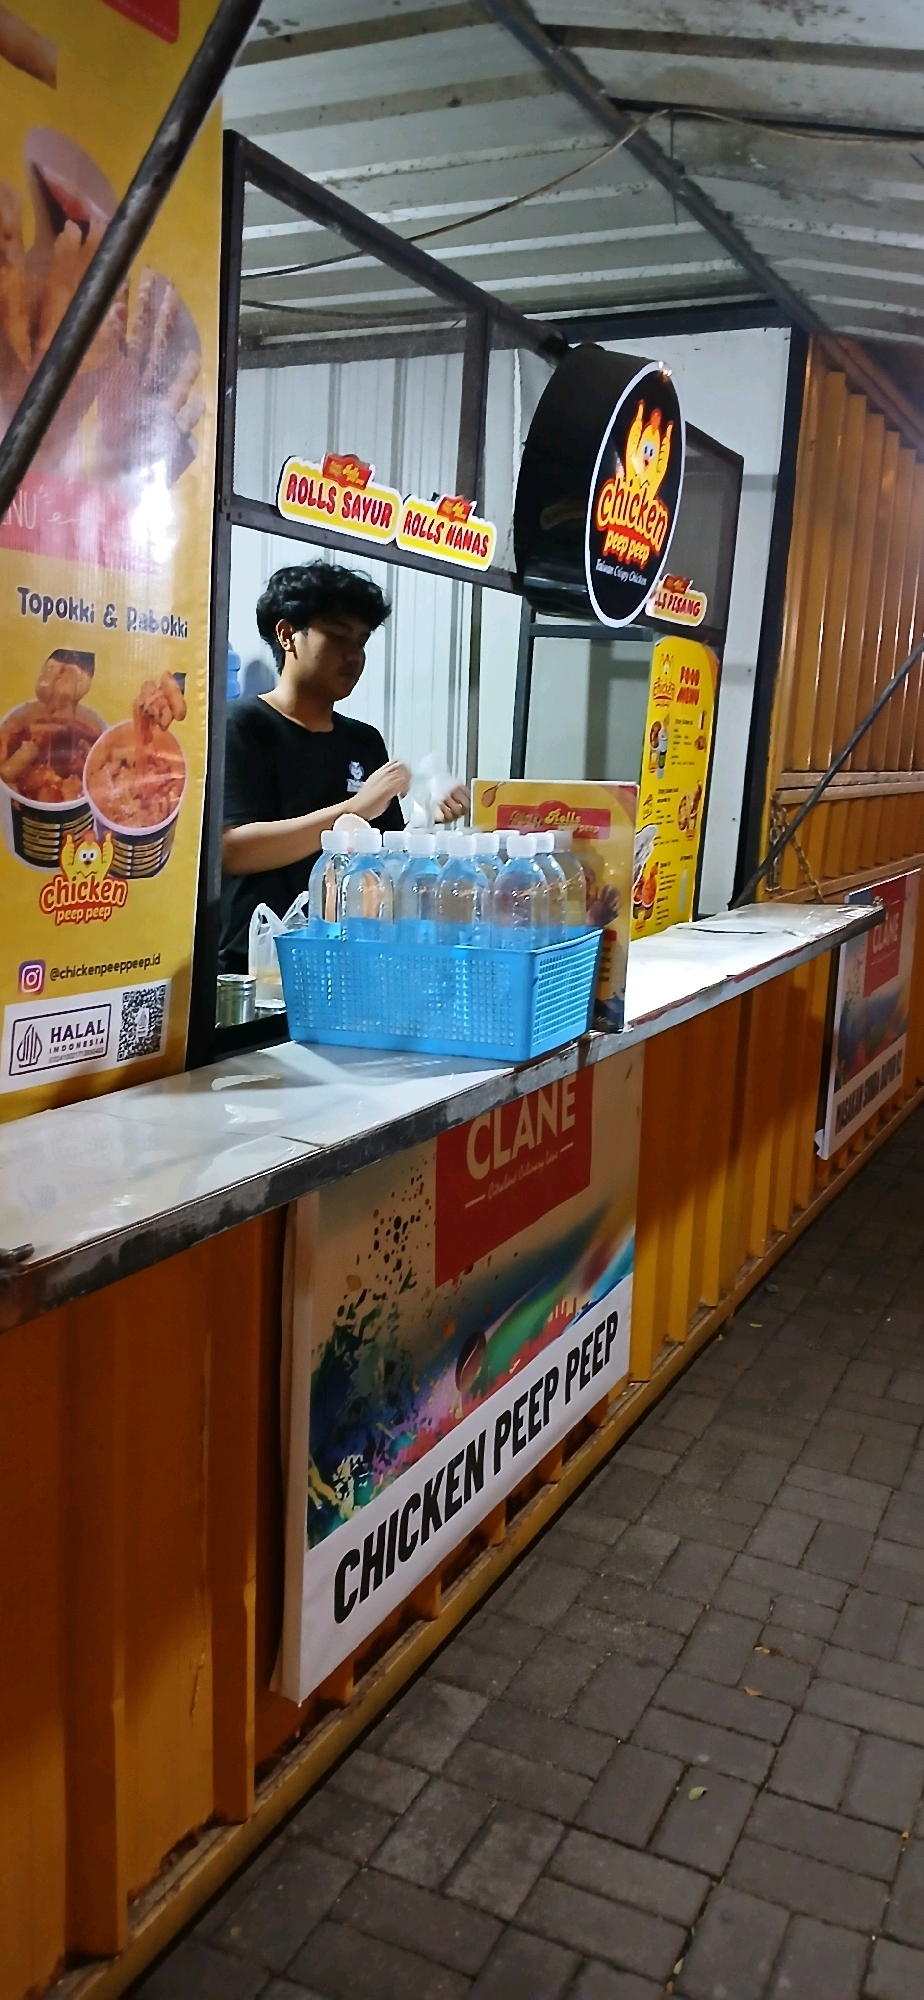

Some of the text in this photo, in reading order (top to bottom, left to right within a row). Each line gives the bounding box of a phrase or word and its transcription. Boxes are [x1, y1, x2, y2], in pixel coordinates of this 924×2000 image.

[286, 473, 337, 515] ROLLS
[341, 490, 393, 529] SAYUR
[598, 475, 668, 552] chicken
[403, 510, 445, 544] ROLLS
[445, 524, 490, 558] NANAS
[604, 530, 650, 565] peep peep
[17, 586, 95, 623] Topokki
[103, 604, 118, 629] &
[667, 594, 701, 617] PISANG
[41, 875, 127, 912] chicken
[57, 906, 112, 925] peep peep
[873, 912, 900, 953] CLANE
[50, 953, 161, 981] @chickenpeeppeep.id
[49, 1037, 104, 1054] INDONESIA
[50, 1019, 105, 1043] HALAL
[466, 1073, 577, 1180] CLANE
[334, 1310, 619, 1625] CHICKEN PEEP PEEP
